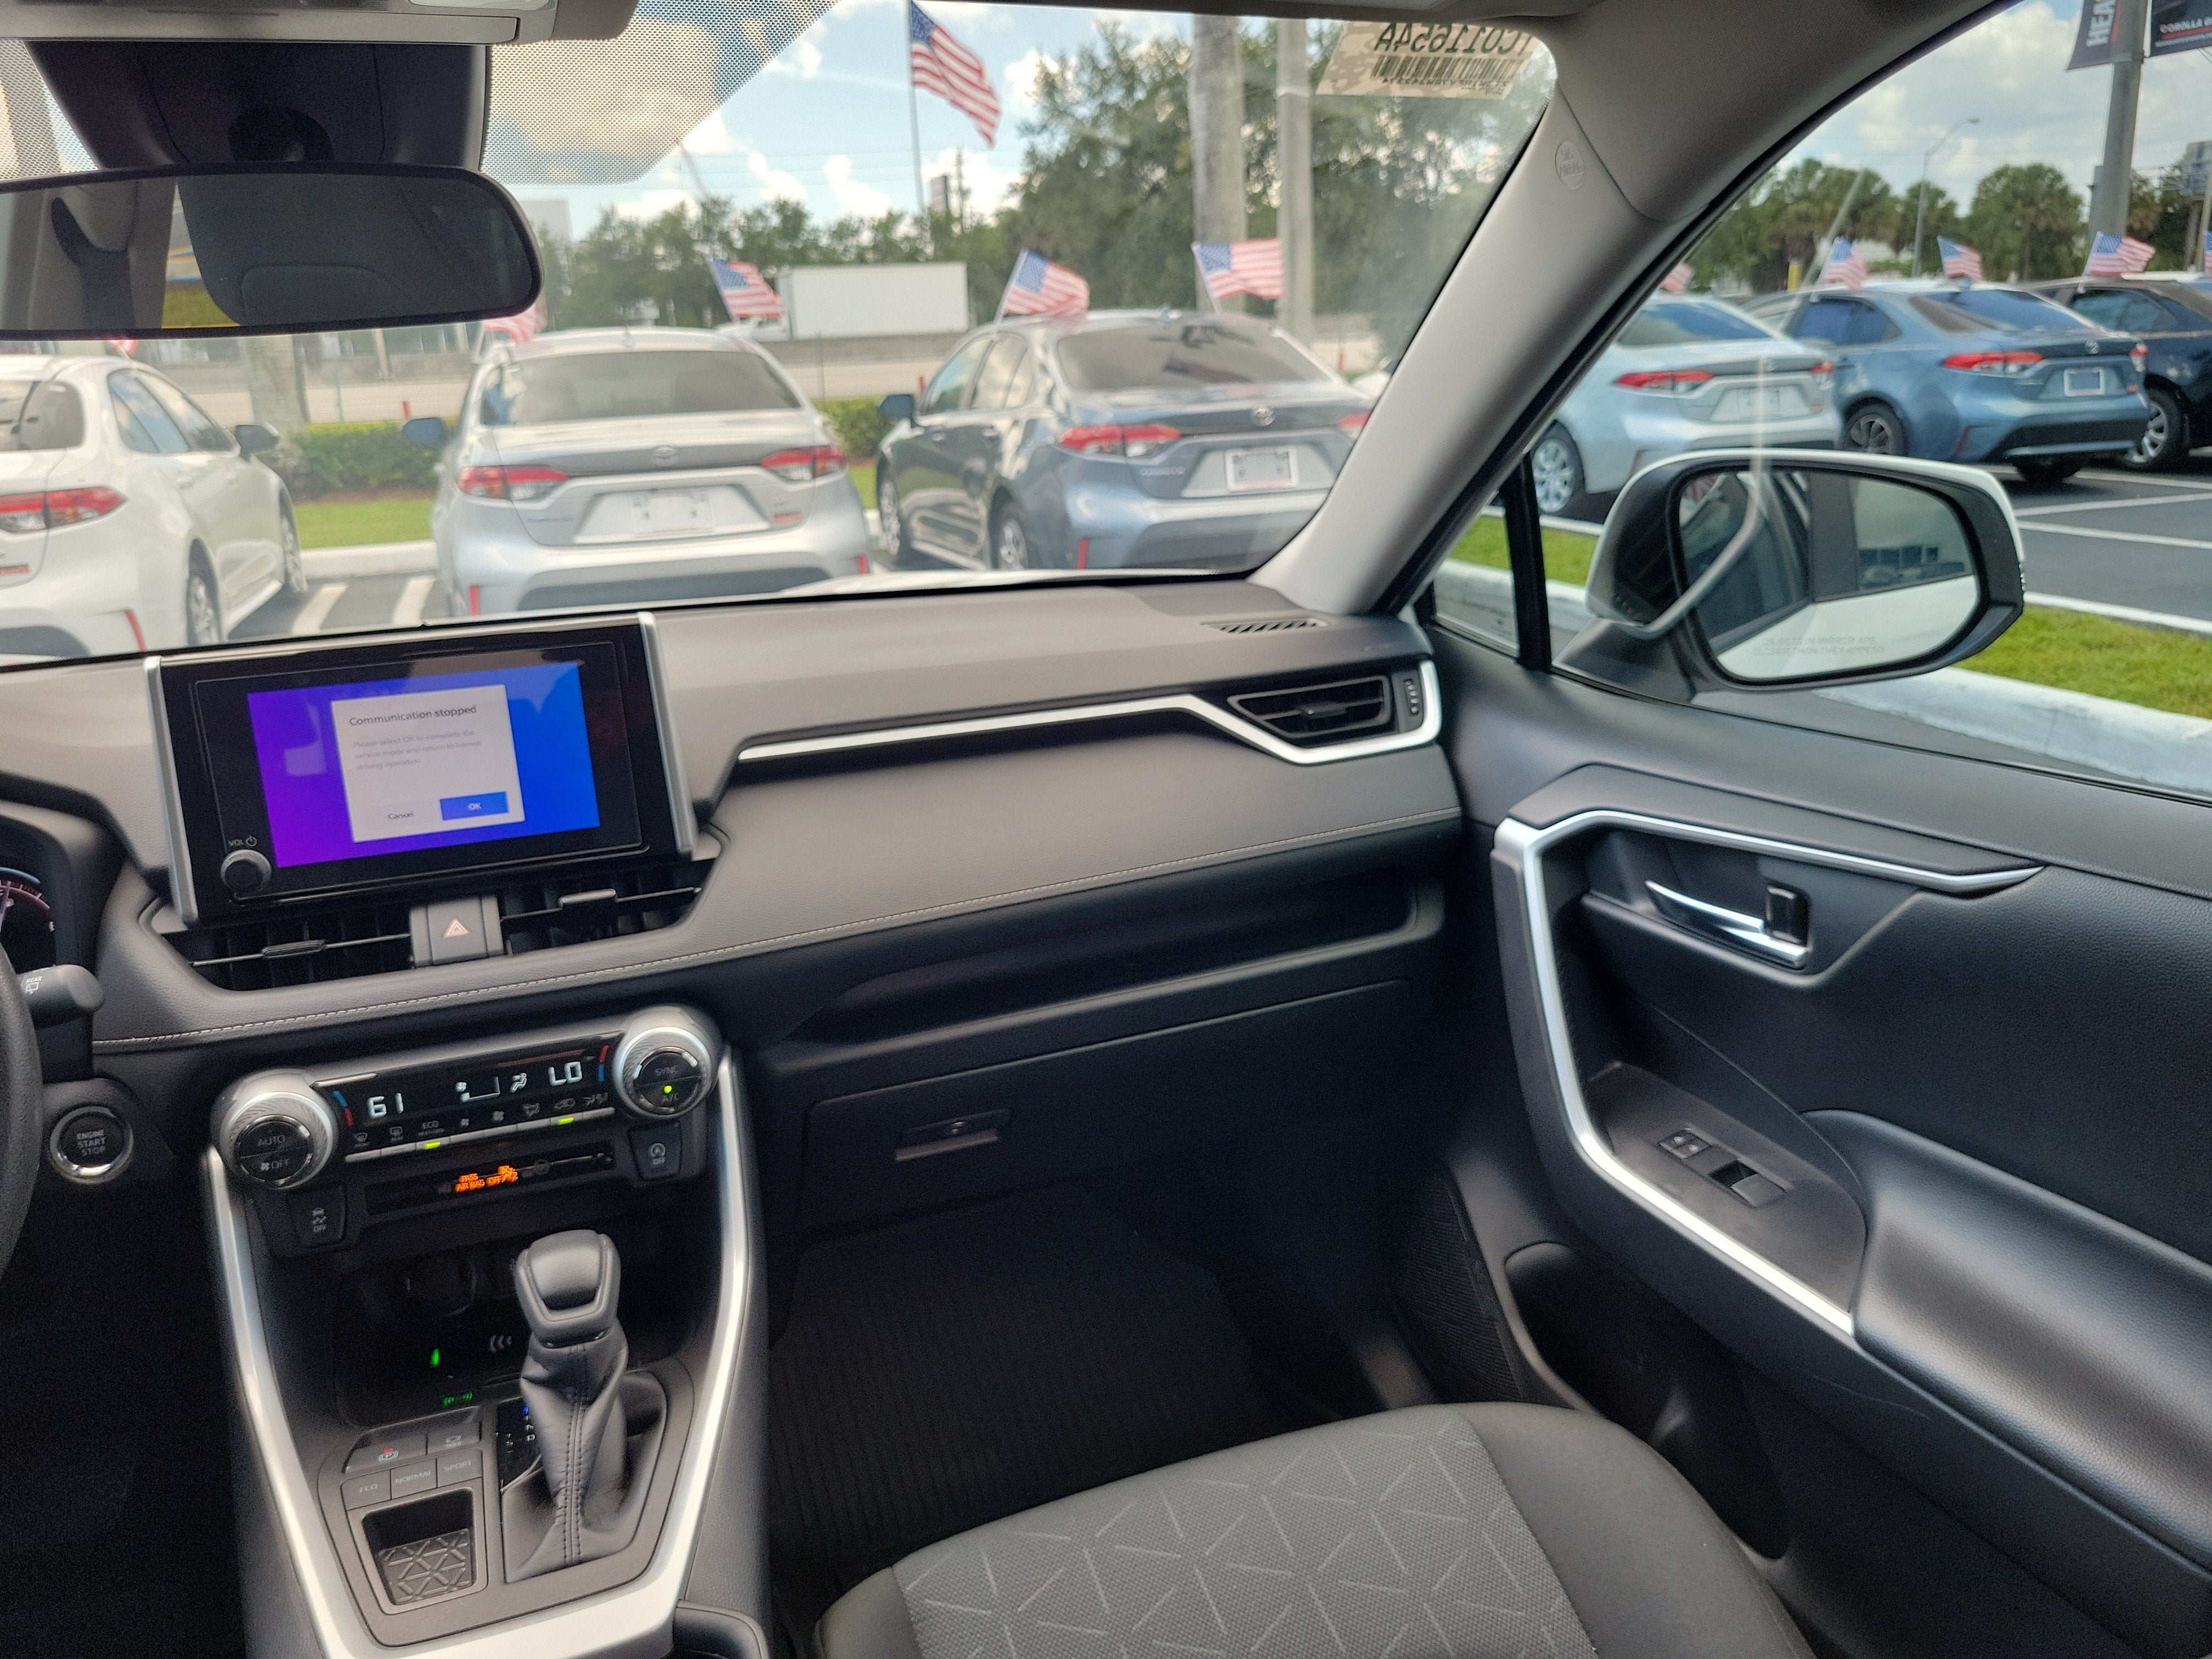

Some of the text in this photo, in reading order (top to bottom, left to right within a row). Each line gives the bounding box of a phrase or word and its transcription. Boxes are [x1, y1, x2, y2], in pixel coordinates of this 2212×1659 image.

[349, 705, 476, 726] Communication stopped
[426, 732, 459, 740] complete
[456, 740, 482, 748] normal
[357, 763, 383, 771] driving
[468, 802, 482, 810] OK
[388, 811, 414, 820] Cancel
[549, 1061, 582, 1086] LO
[368, 1092, 404, 1119] 61
[422, 1120, 439, 1130] ECO
[77, 1138, 105, 1149] START
[258, 1135, 285, 1147] AUTO
[459, 1173, 478, 1182] PASS
[445, 1460, 472, 1472] SPORT
[395, 1470, 431, 1485] NORMAL
